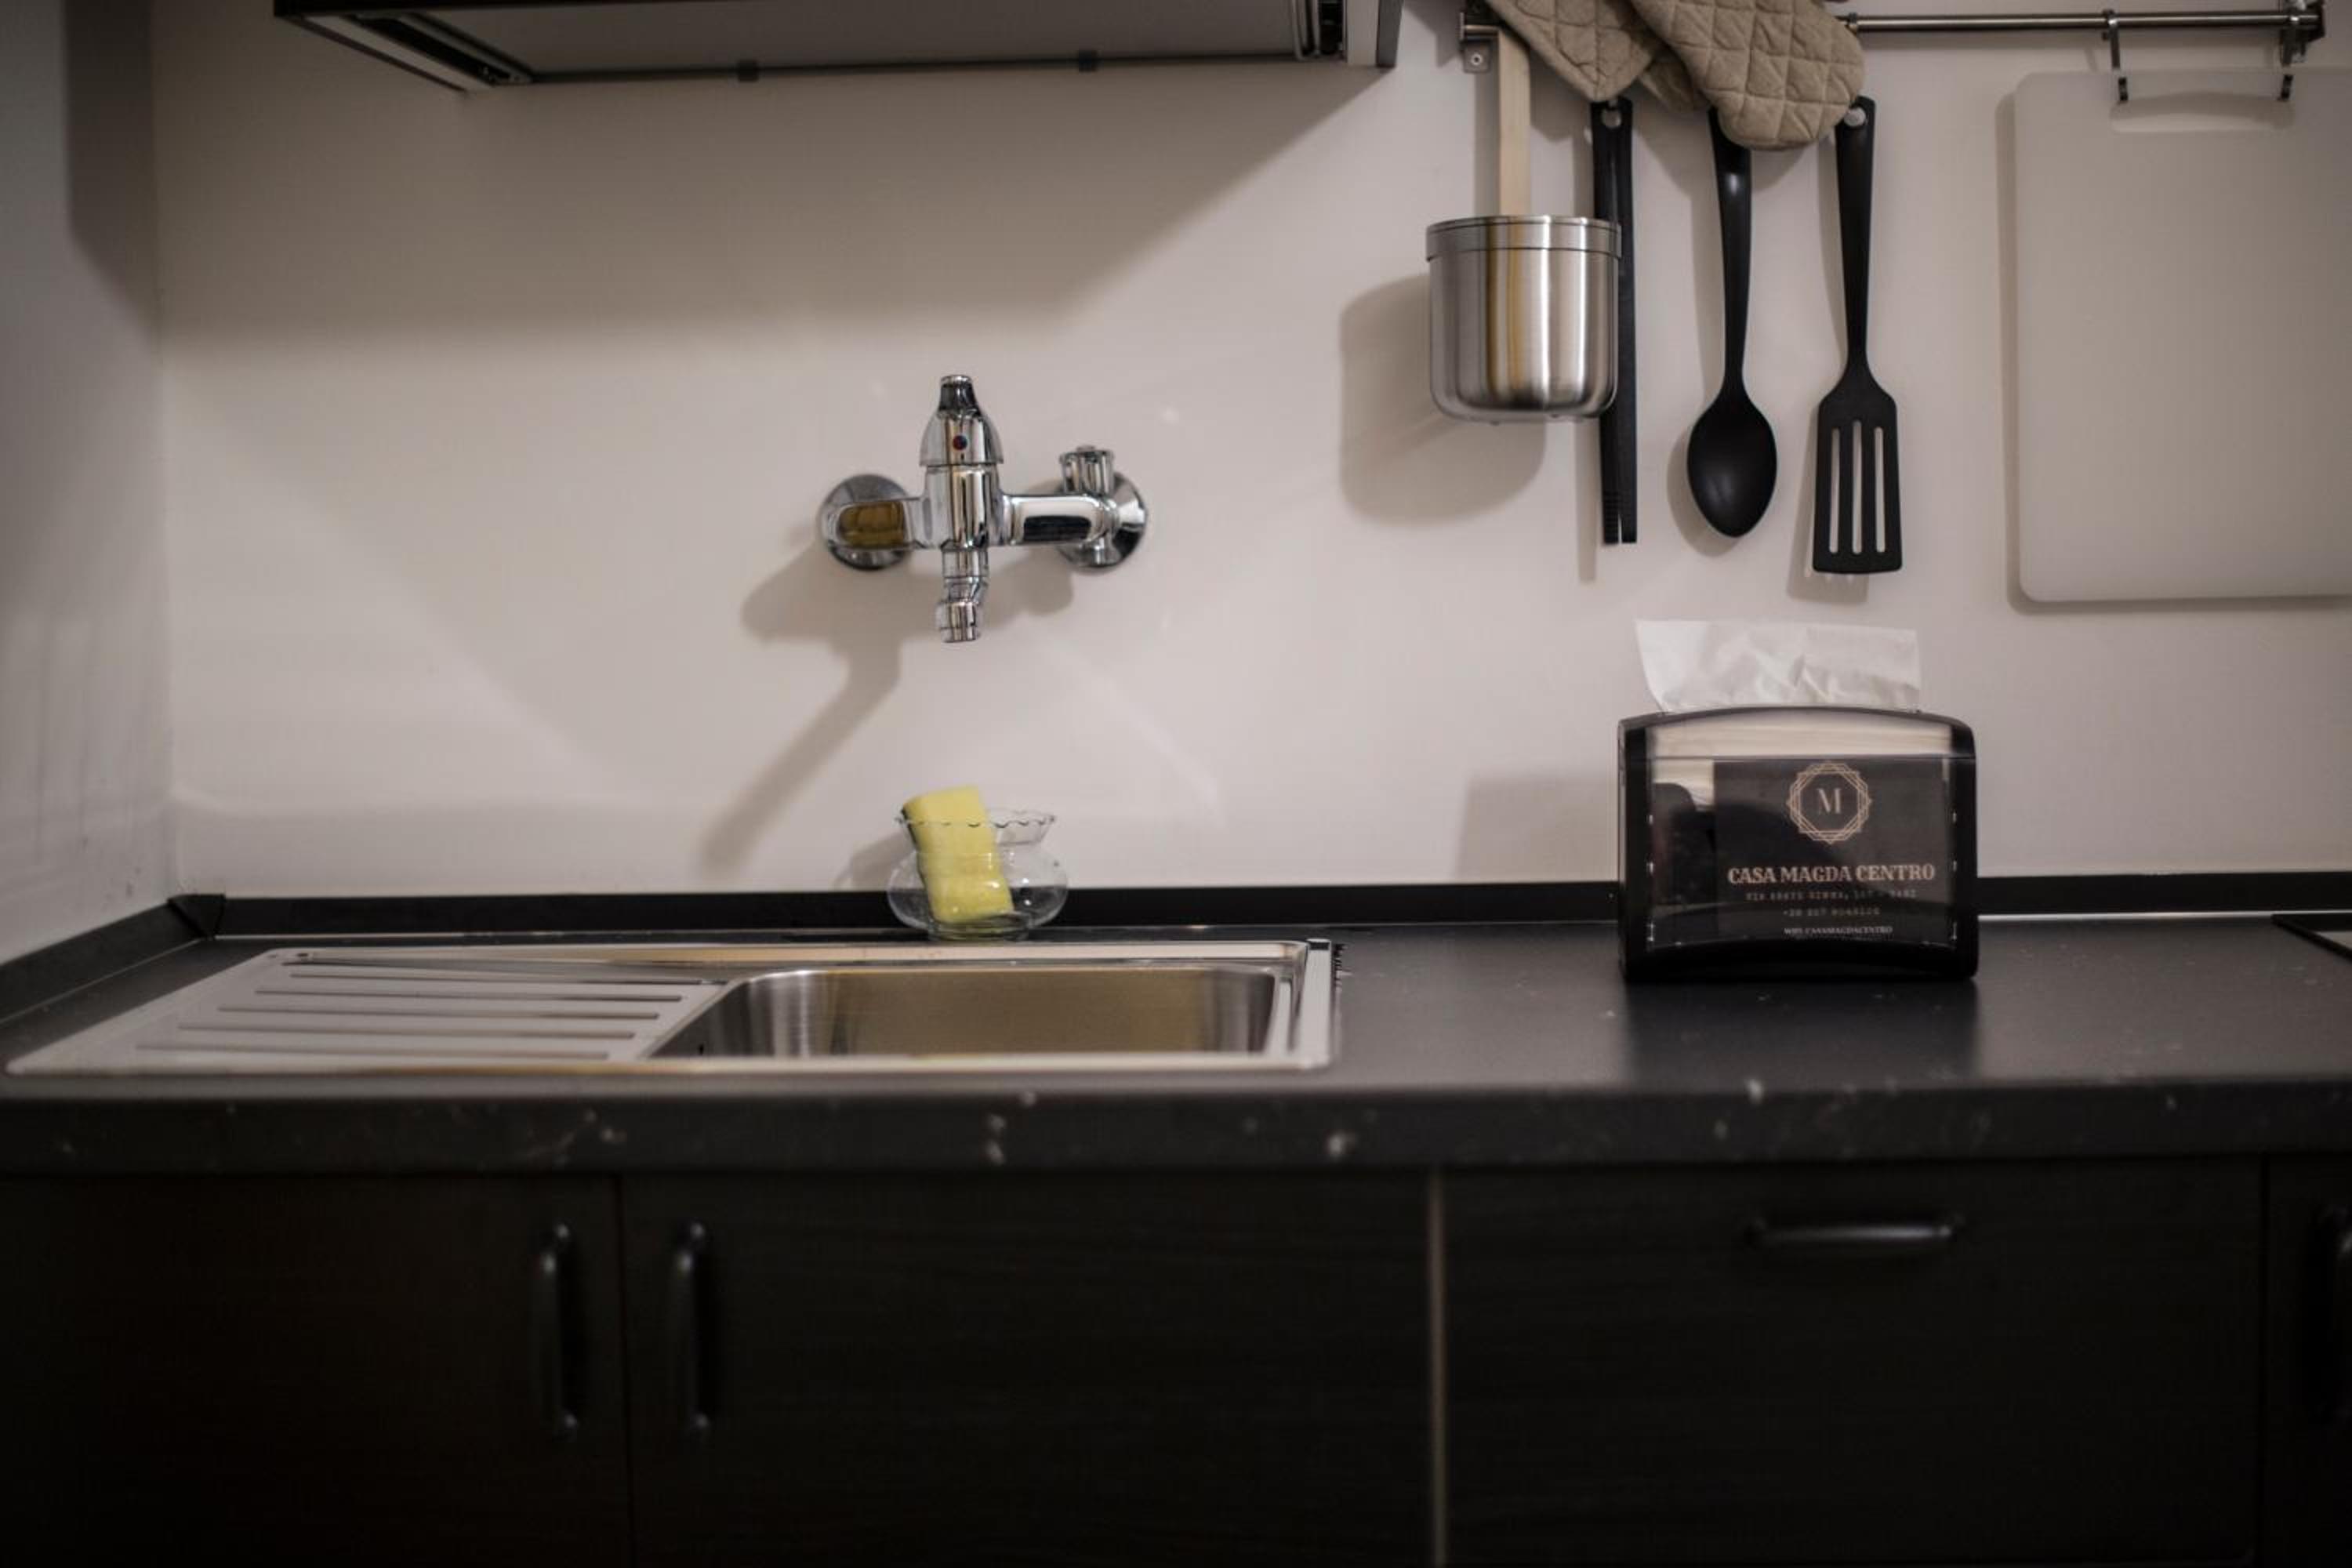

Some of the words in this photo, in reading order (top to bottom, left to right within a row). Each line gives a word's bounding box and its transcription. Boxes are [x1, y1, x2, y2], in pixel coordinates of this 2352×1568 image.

[1817, 787, 1842, 815] M
[1727, 866, 1777, 884] CASA
[1780, 866, 1852, 883] MAGDA
[1855, 864, 1936, 882] CENTRO
